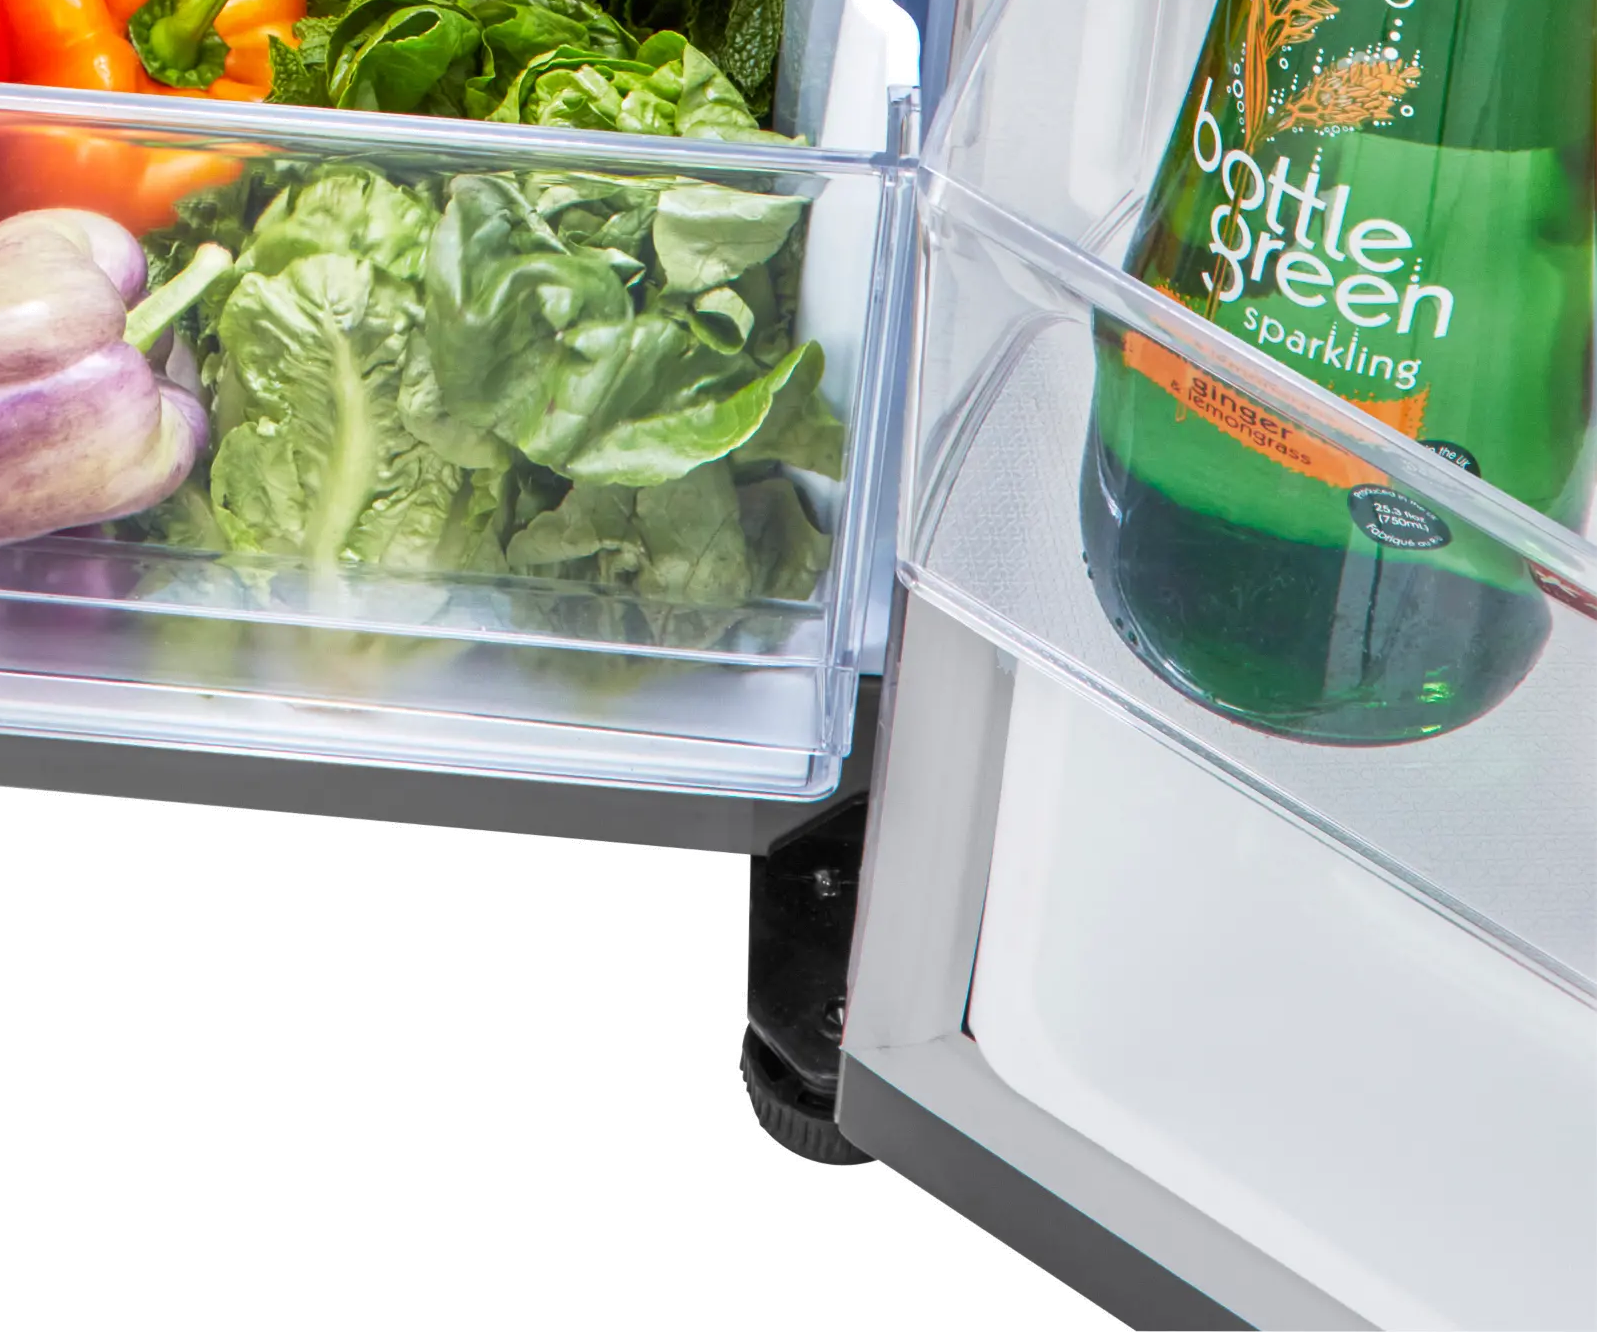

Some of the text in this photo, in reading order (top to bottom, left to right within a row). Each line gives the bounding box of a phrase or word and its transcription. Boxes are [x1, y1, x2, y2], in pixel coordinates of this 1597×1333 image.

[1193, 75, 1414, 275] bottle
[1200, 203, 1455, 340] green
[1242, 305, 1423, 391] sparkling
[1187, 386, 1313, 467] lemongrass
[1192, 376, 1293, 441] ginger
